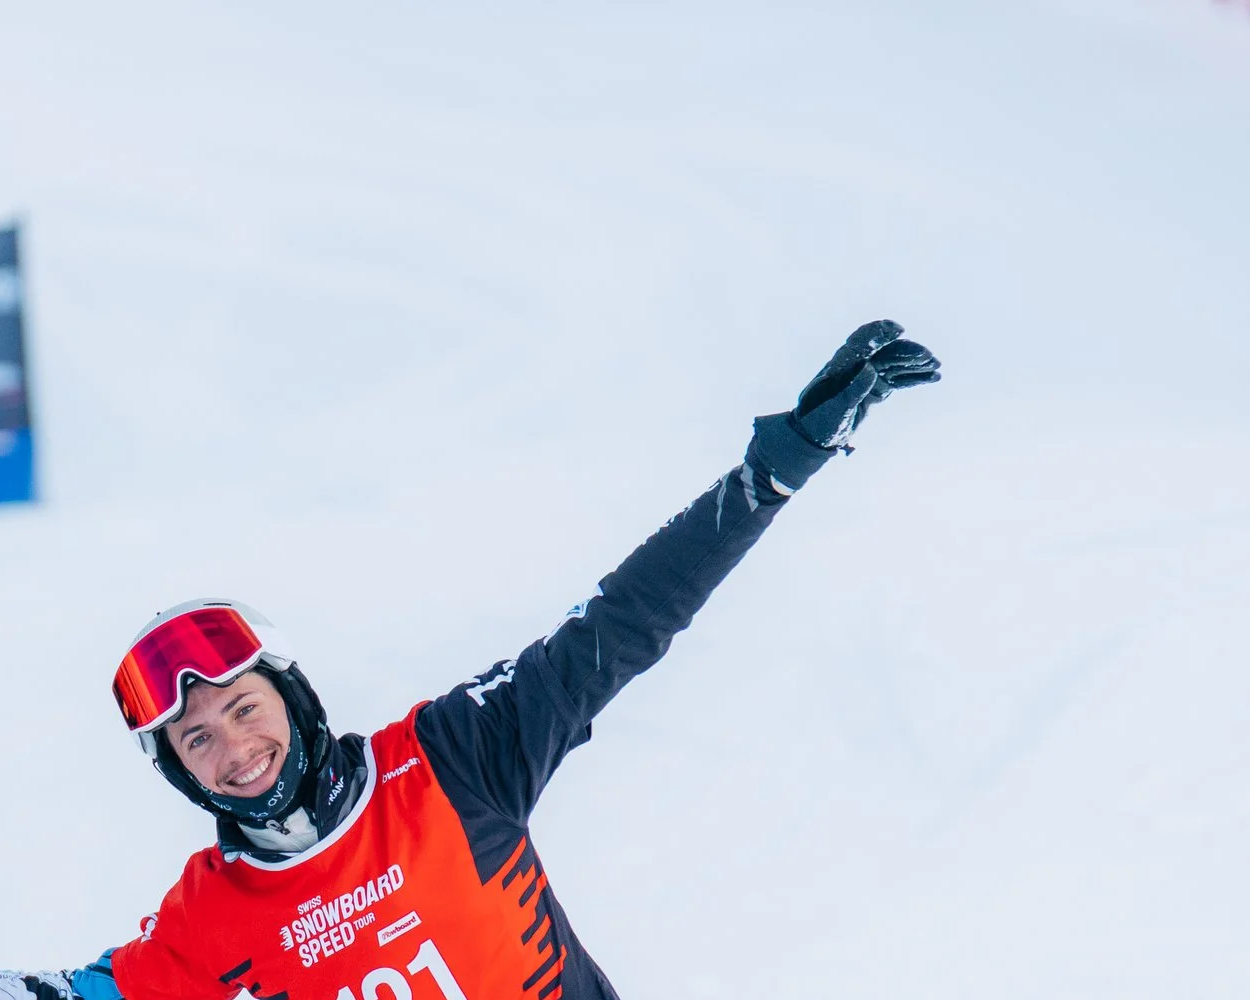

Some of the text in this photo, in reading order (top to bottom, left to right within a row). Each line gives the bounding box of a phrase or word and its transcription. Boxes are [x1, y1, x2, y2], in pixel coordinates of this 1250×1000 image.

[291, 863, 405, 944] SNOWBOARD
[297, 895, 322, 915] SWISS
[299, 912, 376, 968] SPEED TOUR
